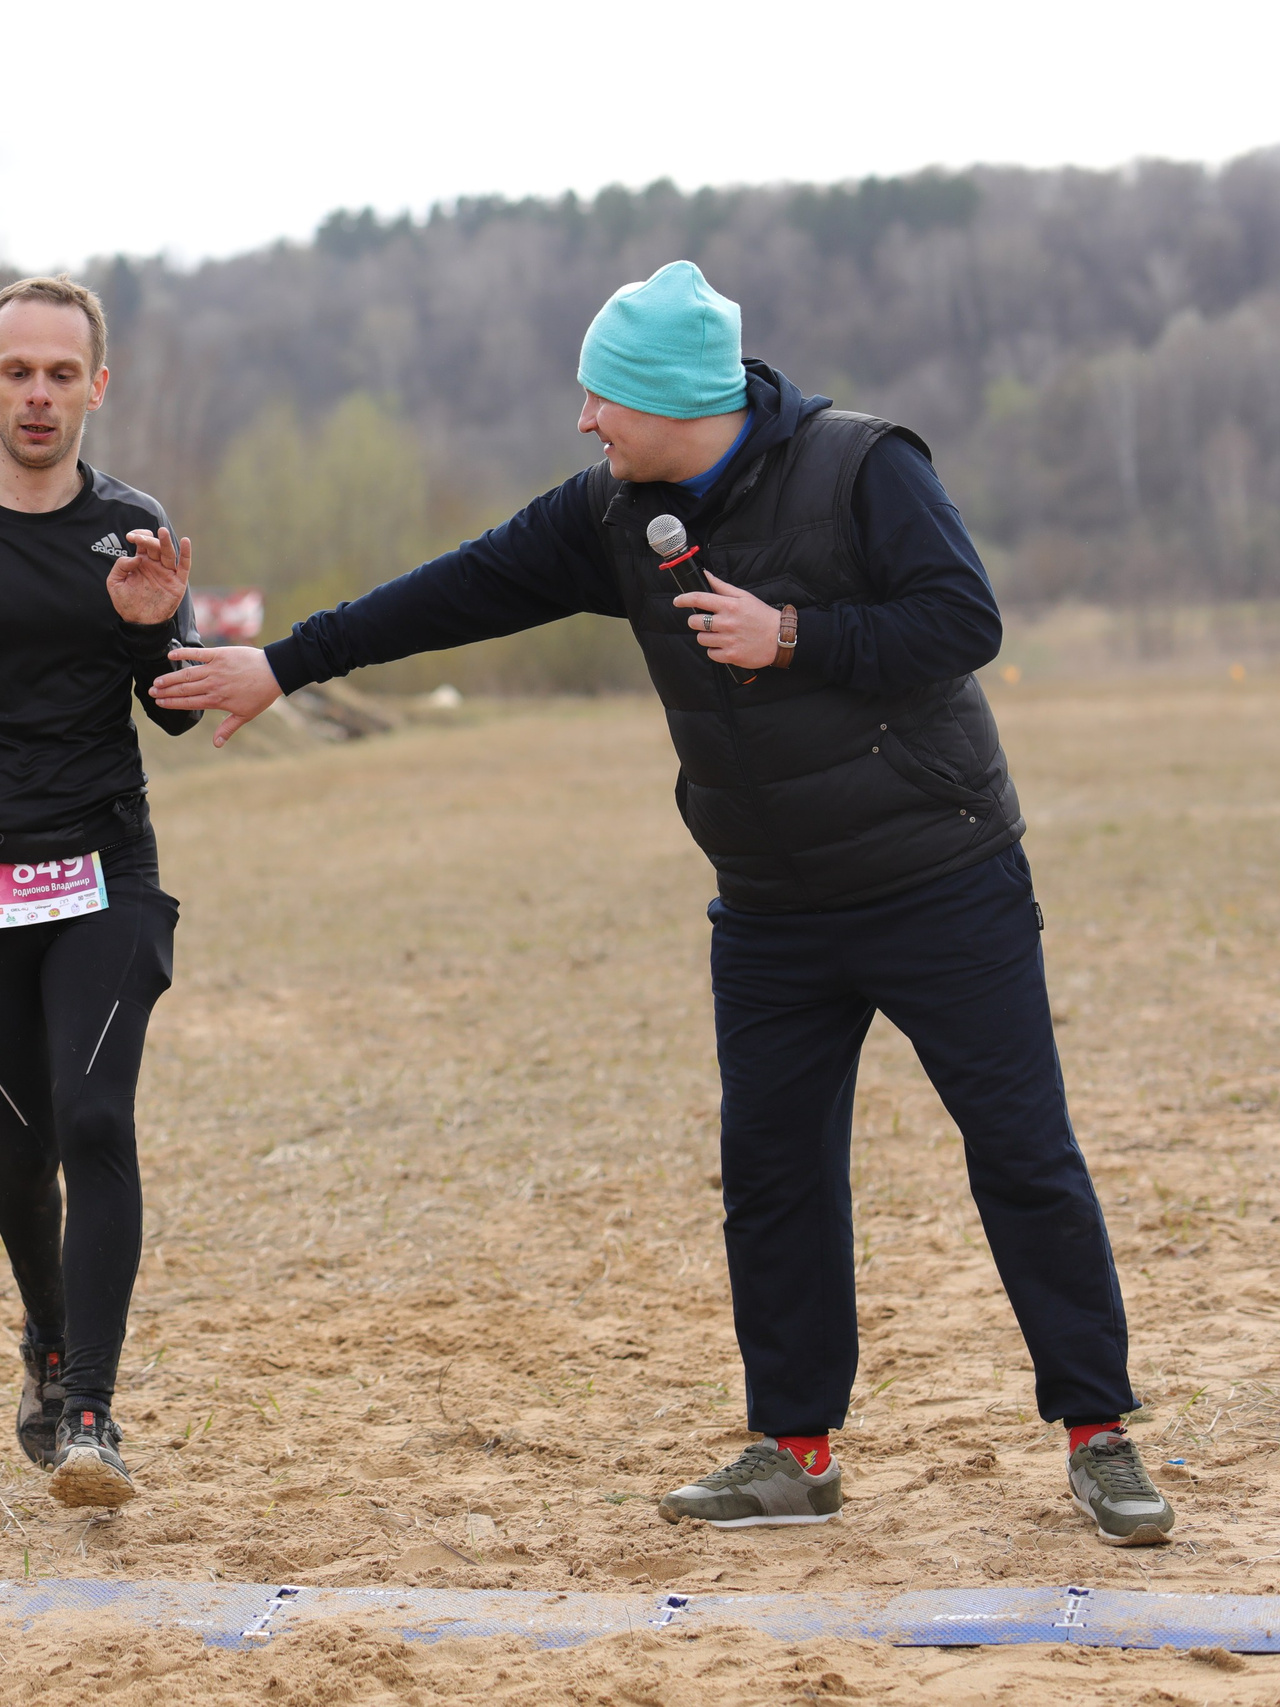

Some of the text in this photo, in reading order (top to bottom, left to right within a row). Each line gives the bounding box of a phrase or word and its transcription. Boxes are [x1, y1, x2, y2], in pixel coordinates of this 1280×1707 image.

[91, 545, 128, 557] adidas
[12, 856, 83, 884] 849
[13, 877, 90, 897] Родионов Владимир
